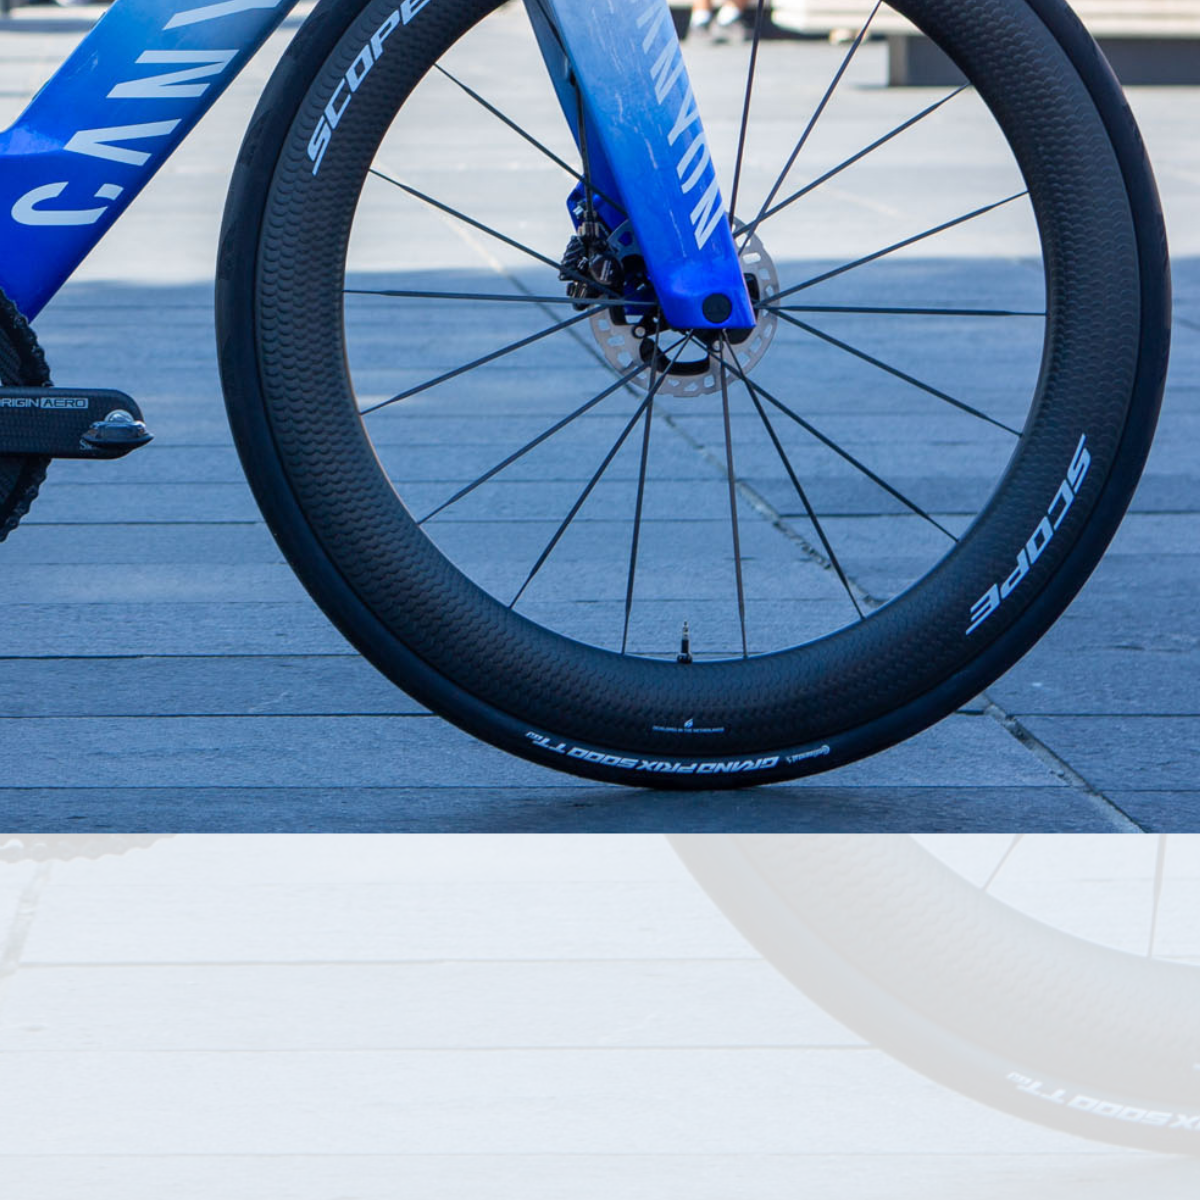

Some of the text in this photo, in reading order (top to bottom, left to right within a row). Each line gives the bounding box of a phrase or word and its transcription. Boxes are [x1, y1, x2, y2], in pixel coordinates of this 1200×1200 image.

[966, 433, 1091, 636] SCOPE
[566, 747, 639, 769] 5000
[636, 759, 698, 774] PRIX
[696, 756, 780, 774] GRAND
